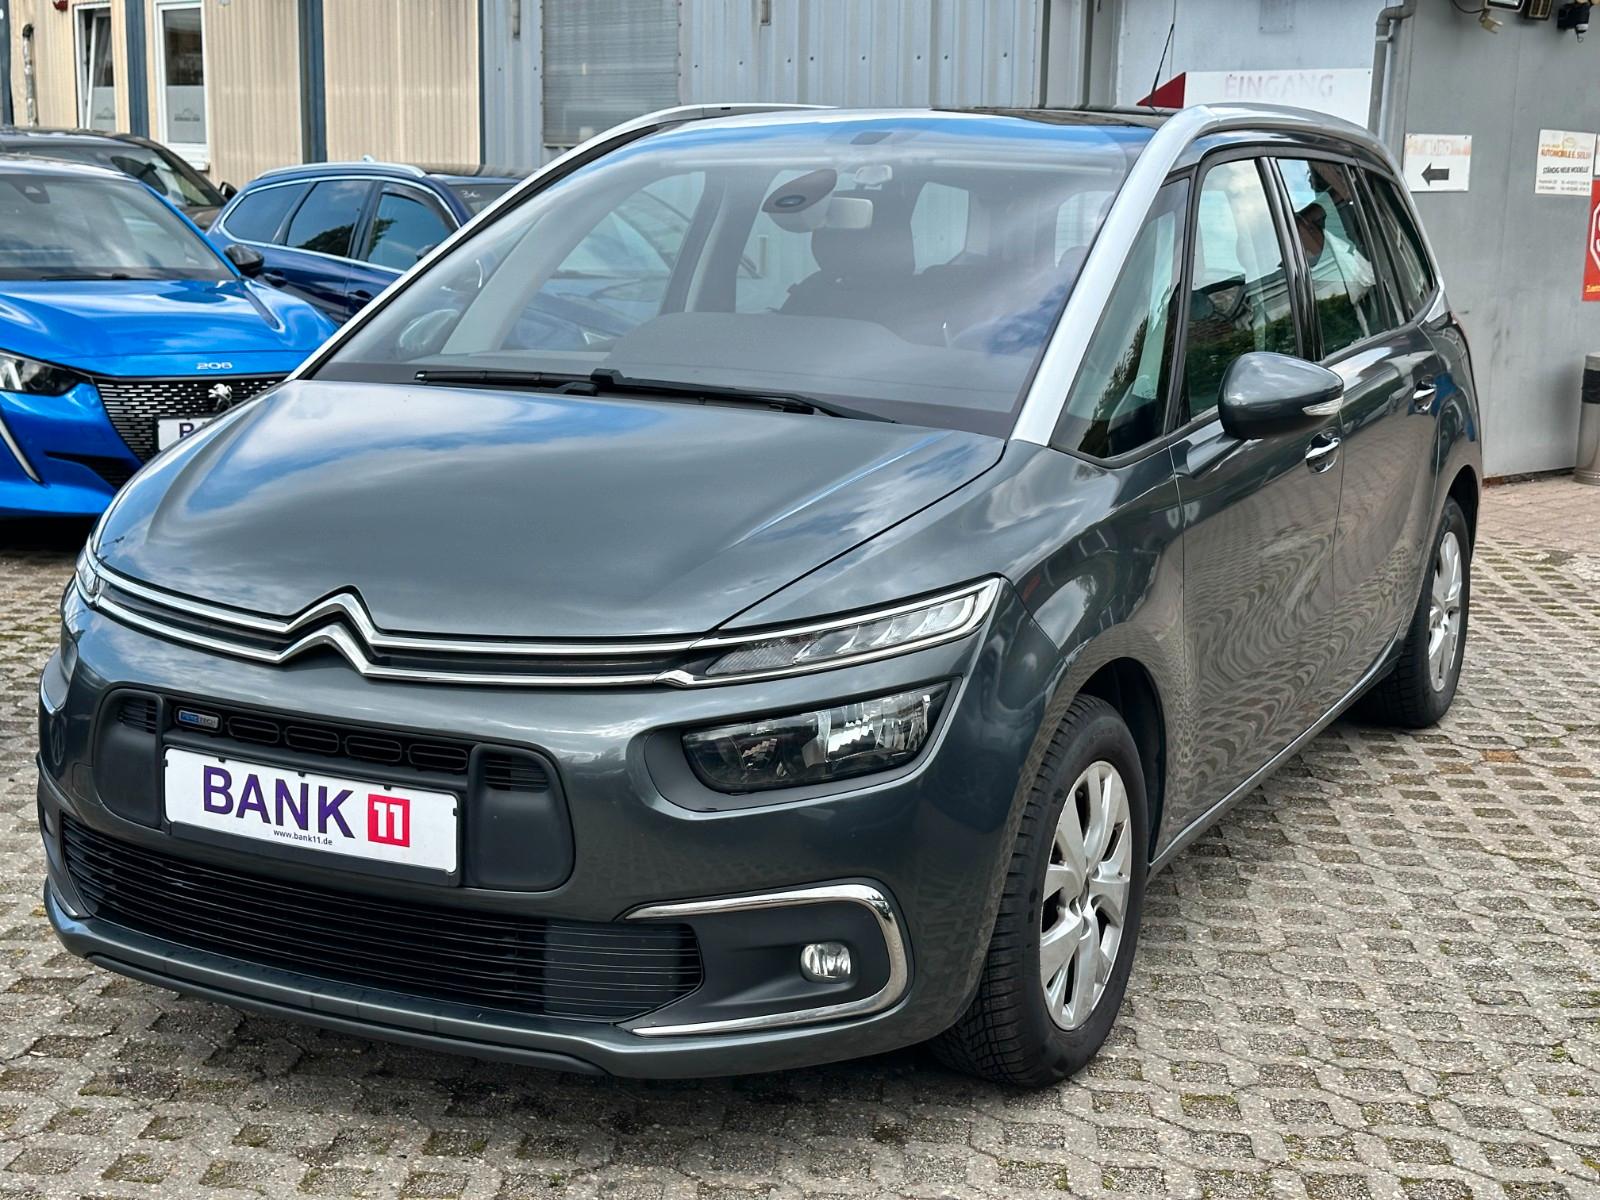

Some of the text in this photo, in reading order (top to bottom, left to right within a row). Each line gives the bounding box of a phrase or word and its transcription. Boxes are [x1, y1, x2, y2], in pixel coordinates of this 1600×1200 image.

[1224, 73, 1335, 98] EINGANG
[196, 362, 233, 370] 208
[203, 764, 405, 842] BANK 11
[273, 828, 333, 846] www.bank11.de
